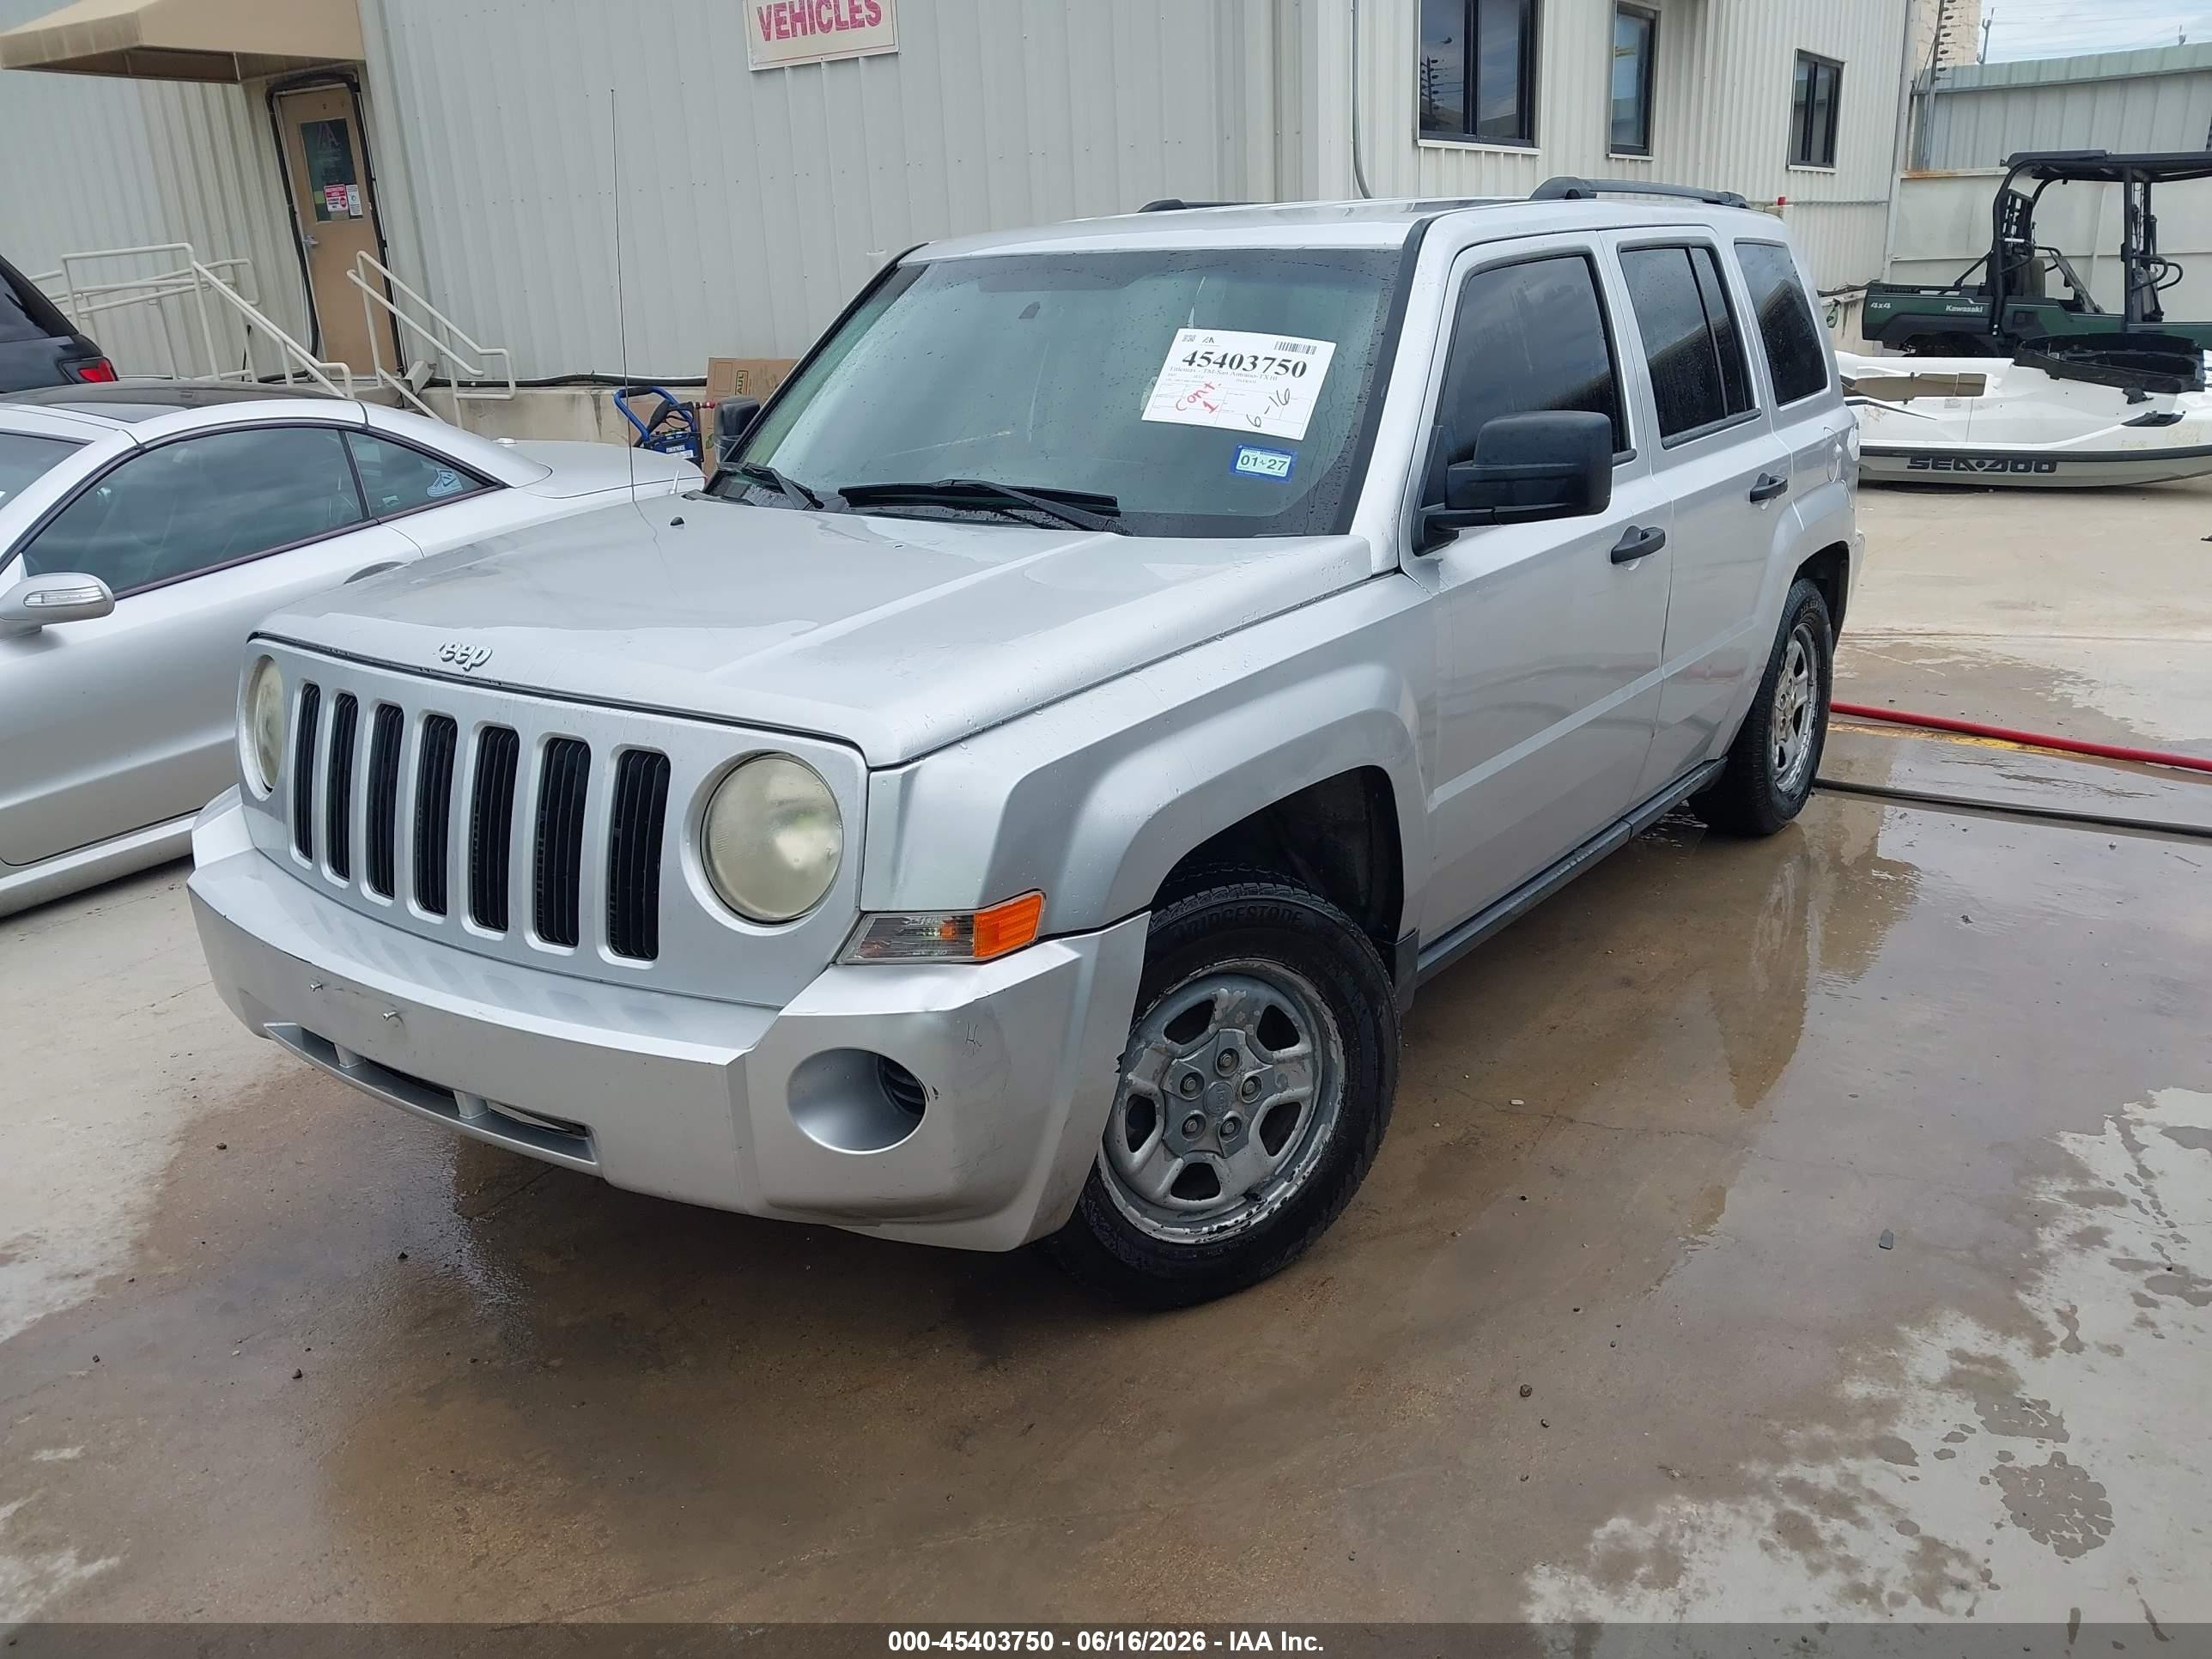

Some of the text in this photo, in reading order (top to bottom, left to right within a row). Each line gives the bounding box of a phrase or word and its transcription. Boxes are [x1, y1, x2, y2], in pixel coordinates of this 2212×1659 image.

[757, 0, 882, 41] VEHICLES
[1945, 304, 1984, 313] Kawasaki
[1182, 349, 1307, 379] 45403750
